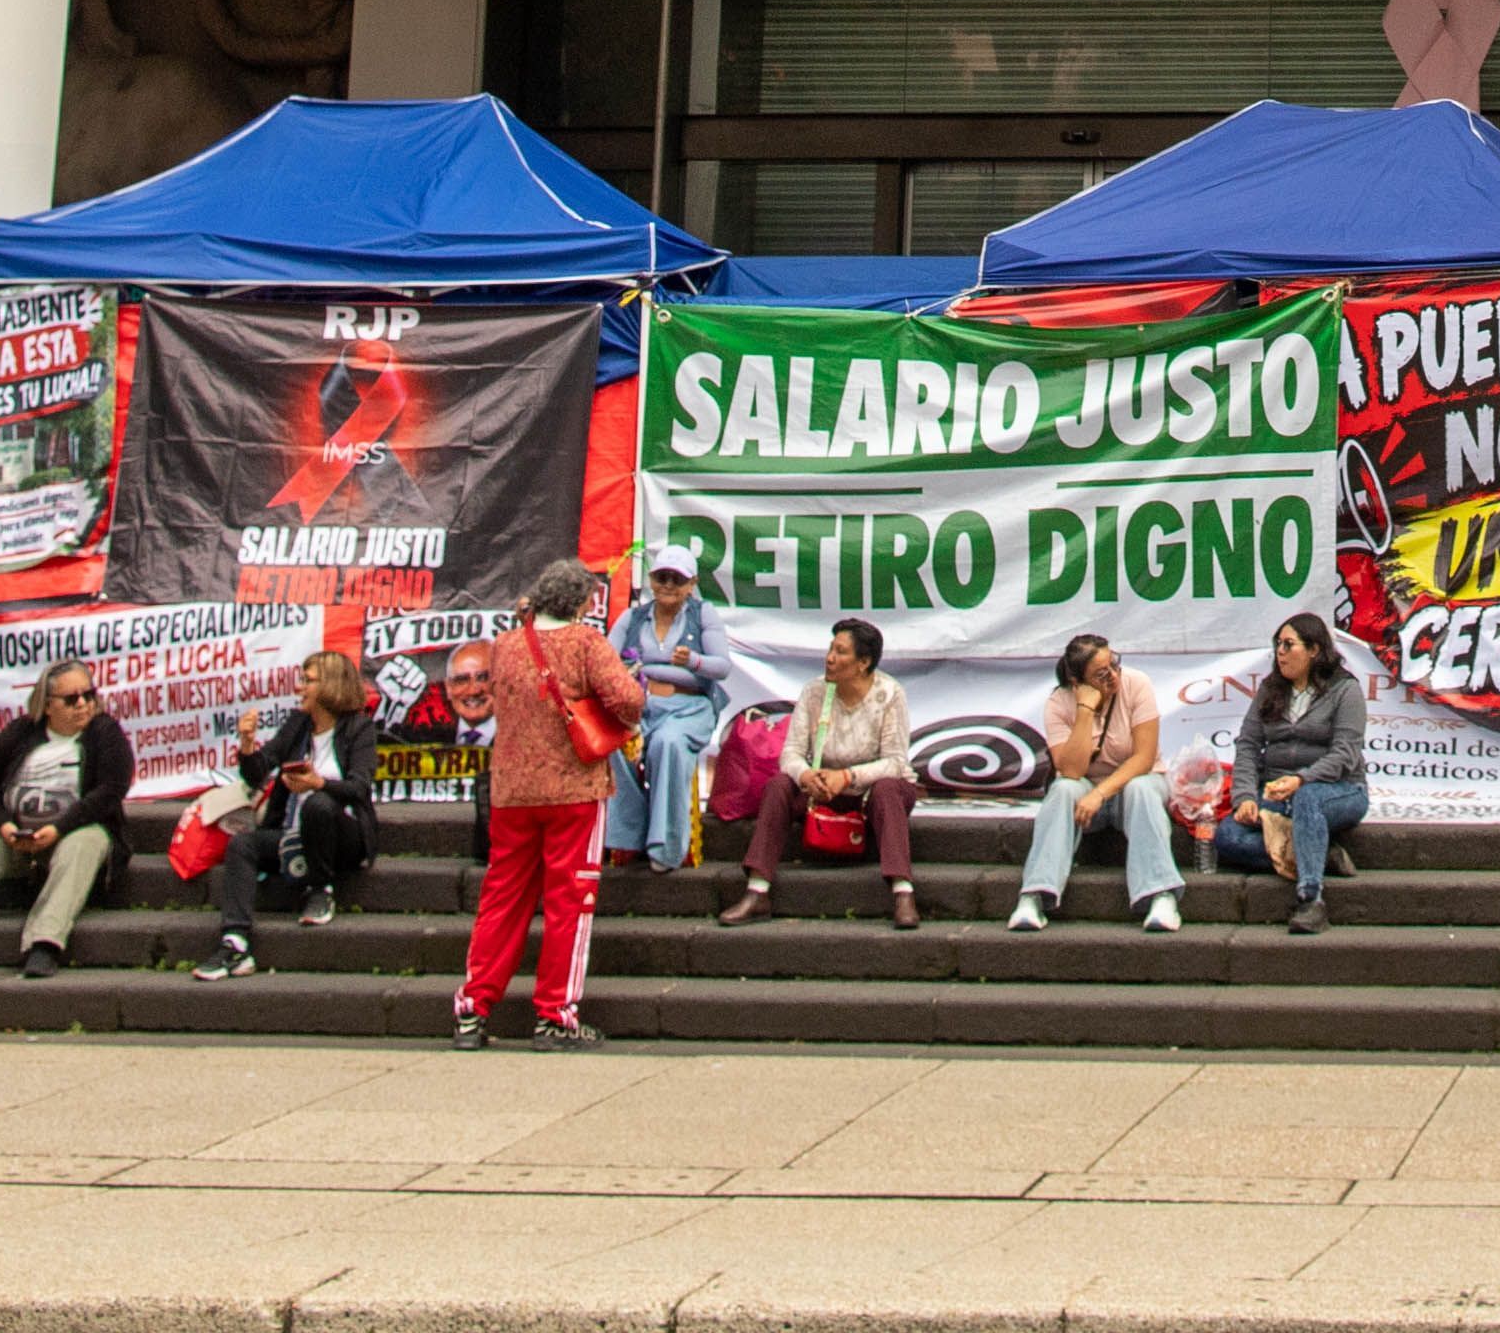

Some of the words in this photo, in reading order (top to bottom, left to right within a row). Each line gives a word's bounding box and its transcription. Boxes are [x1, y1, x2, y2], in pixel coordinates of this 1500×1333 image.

[323, 305, 421, 341] RJP
[23, 328, 78, 372] ESTA
[668, 351, 1041, 459] SALARIO
[1055, 333, 1321, 451] JUSTO
[322, 442, 387, 465] IMSS
[237, 526, 358, 567] SALARIO
[358, 528, 446, 568] JUSTO
[667, 510, 997, 611] RETIRO
[1026, 494, 1314, 607] DIGNO
[236, 566, 336, 605] RETIRO
[341, 568, 434, 610] DIGNO
[129, 602, 309, 649] ESPECIALIDADES
[164, 638, 248, 677] LUCHA
[167, 674, 235, 713] NUESTRO
